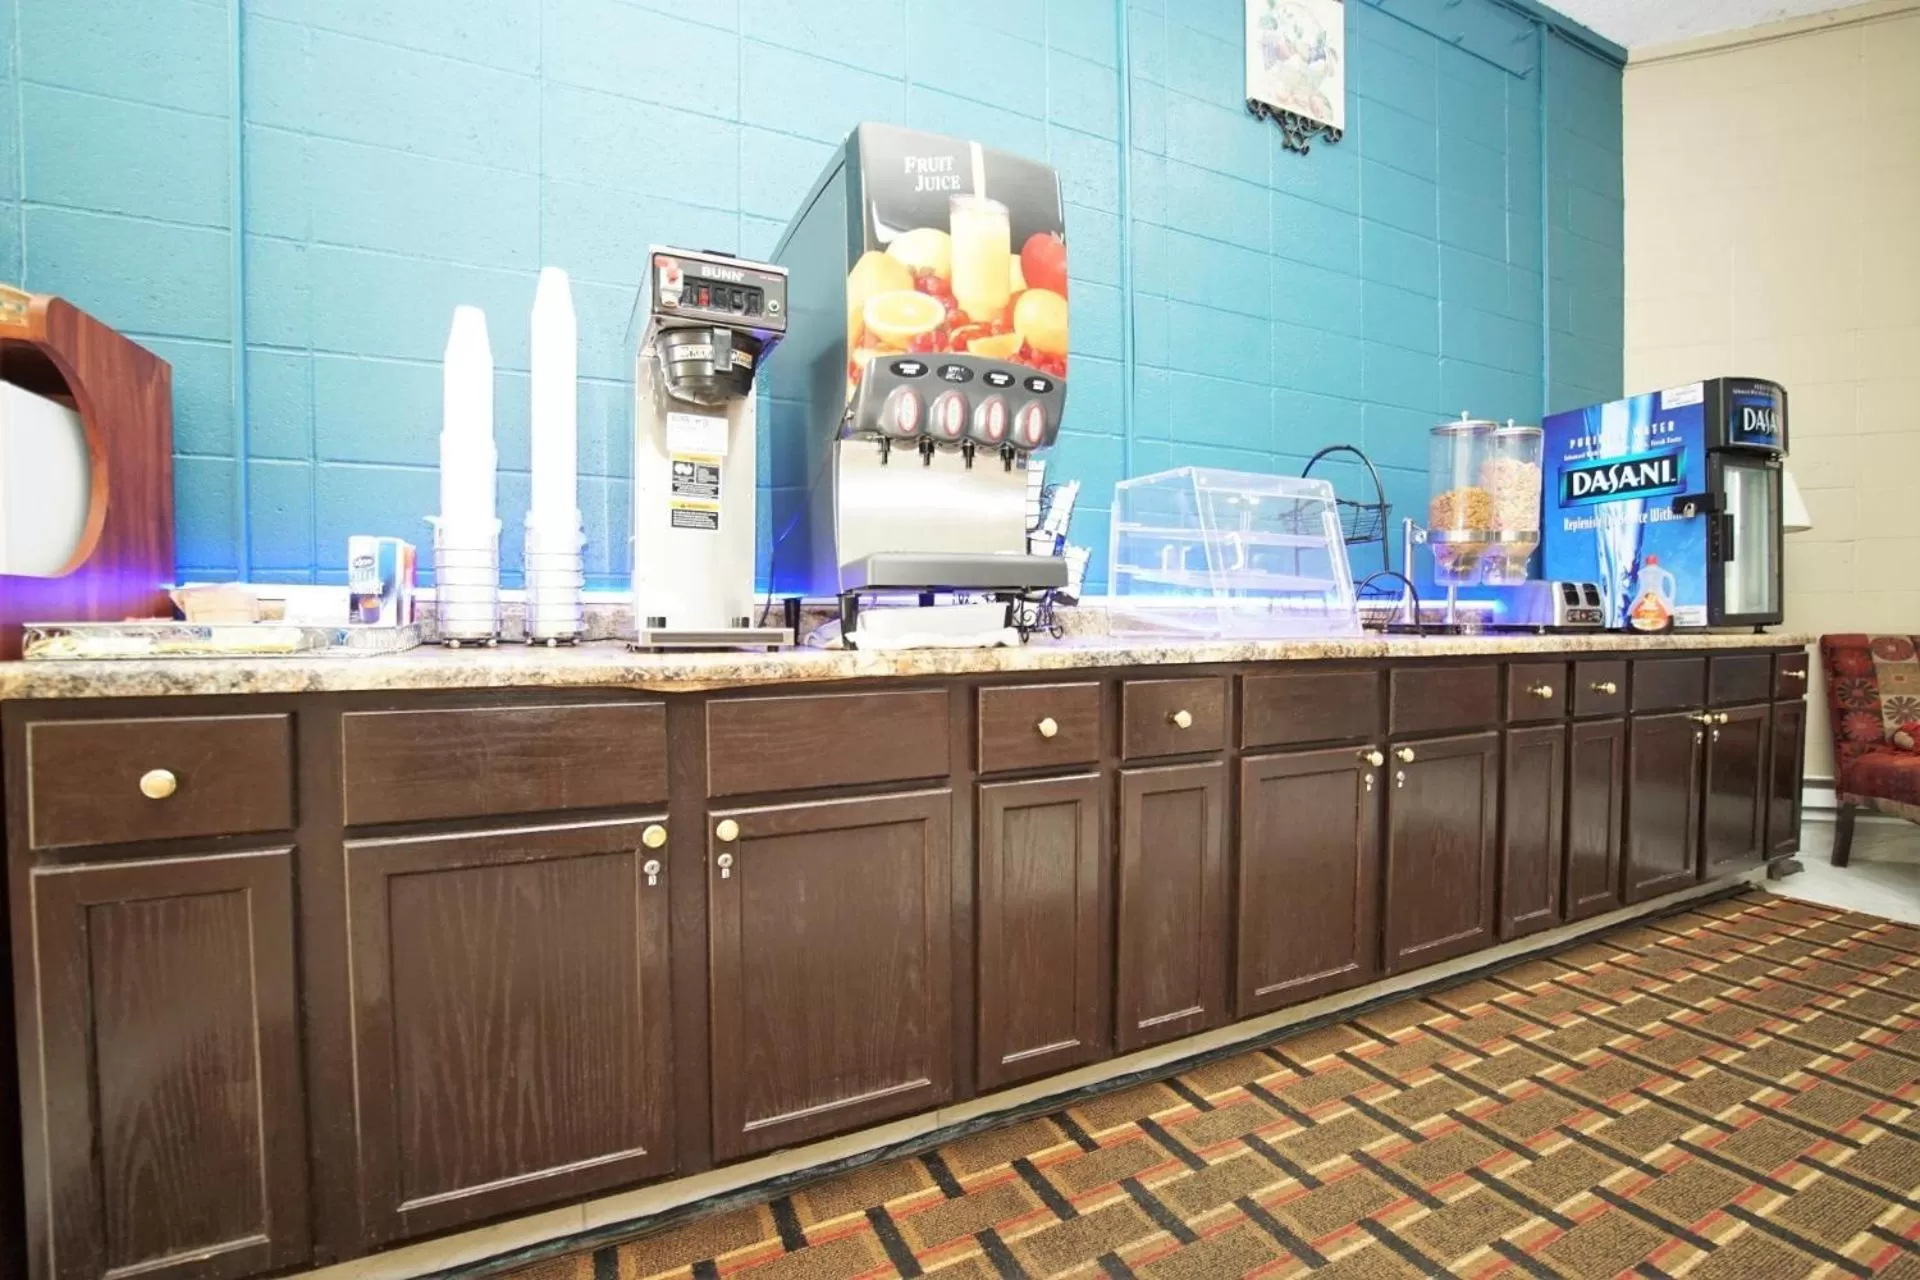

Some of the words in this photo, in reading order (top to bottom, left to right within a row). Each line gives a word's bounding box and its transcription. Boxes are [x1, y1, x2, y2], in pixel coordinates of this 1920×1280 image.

[904, 155, 954, 174] FRUIT
[914, 174, 961, 192] JUICE
[701, 266, 741, 281] BUNN
[1743, 407, 1779, 435] DASA
[1572, 459, 1671, 497] DASANI
[1650, 506, 1683, 522] With
